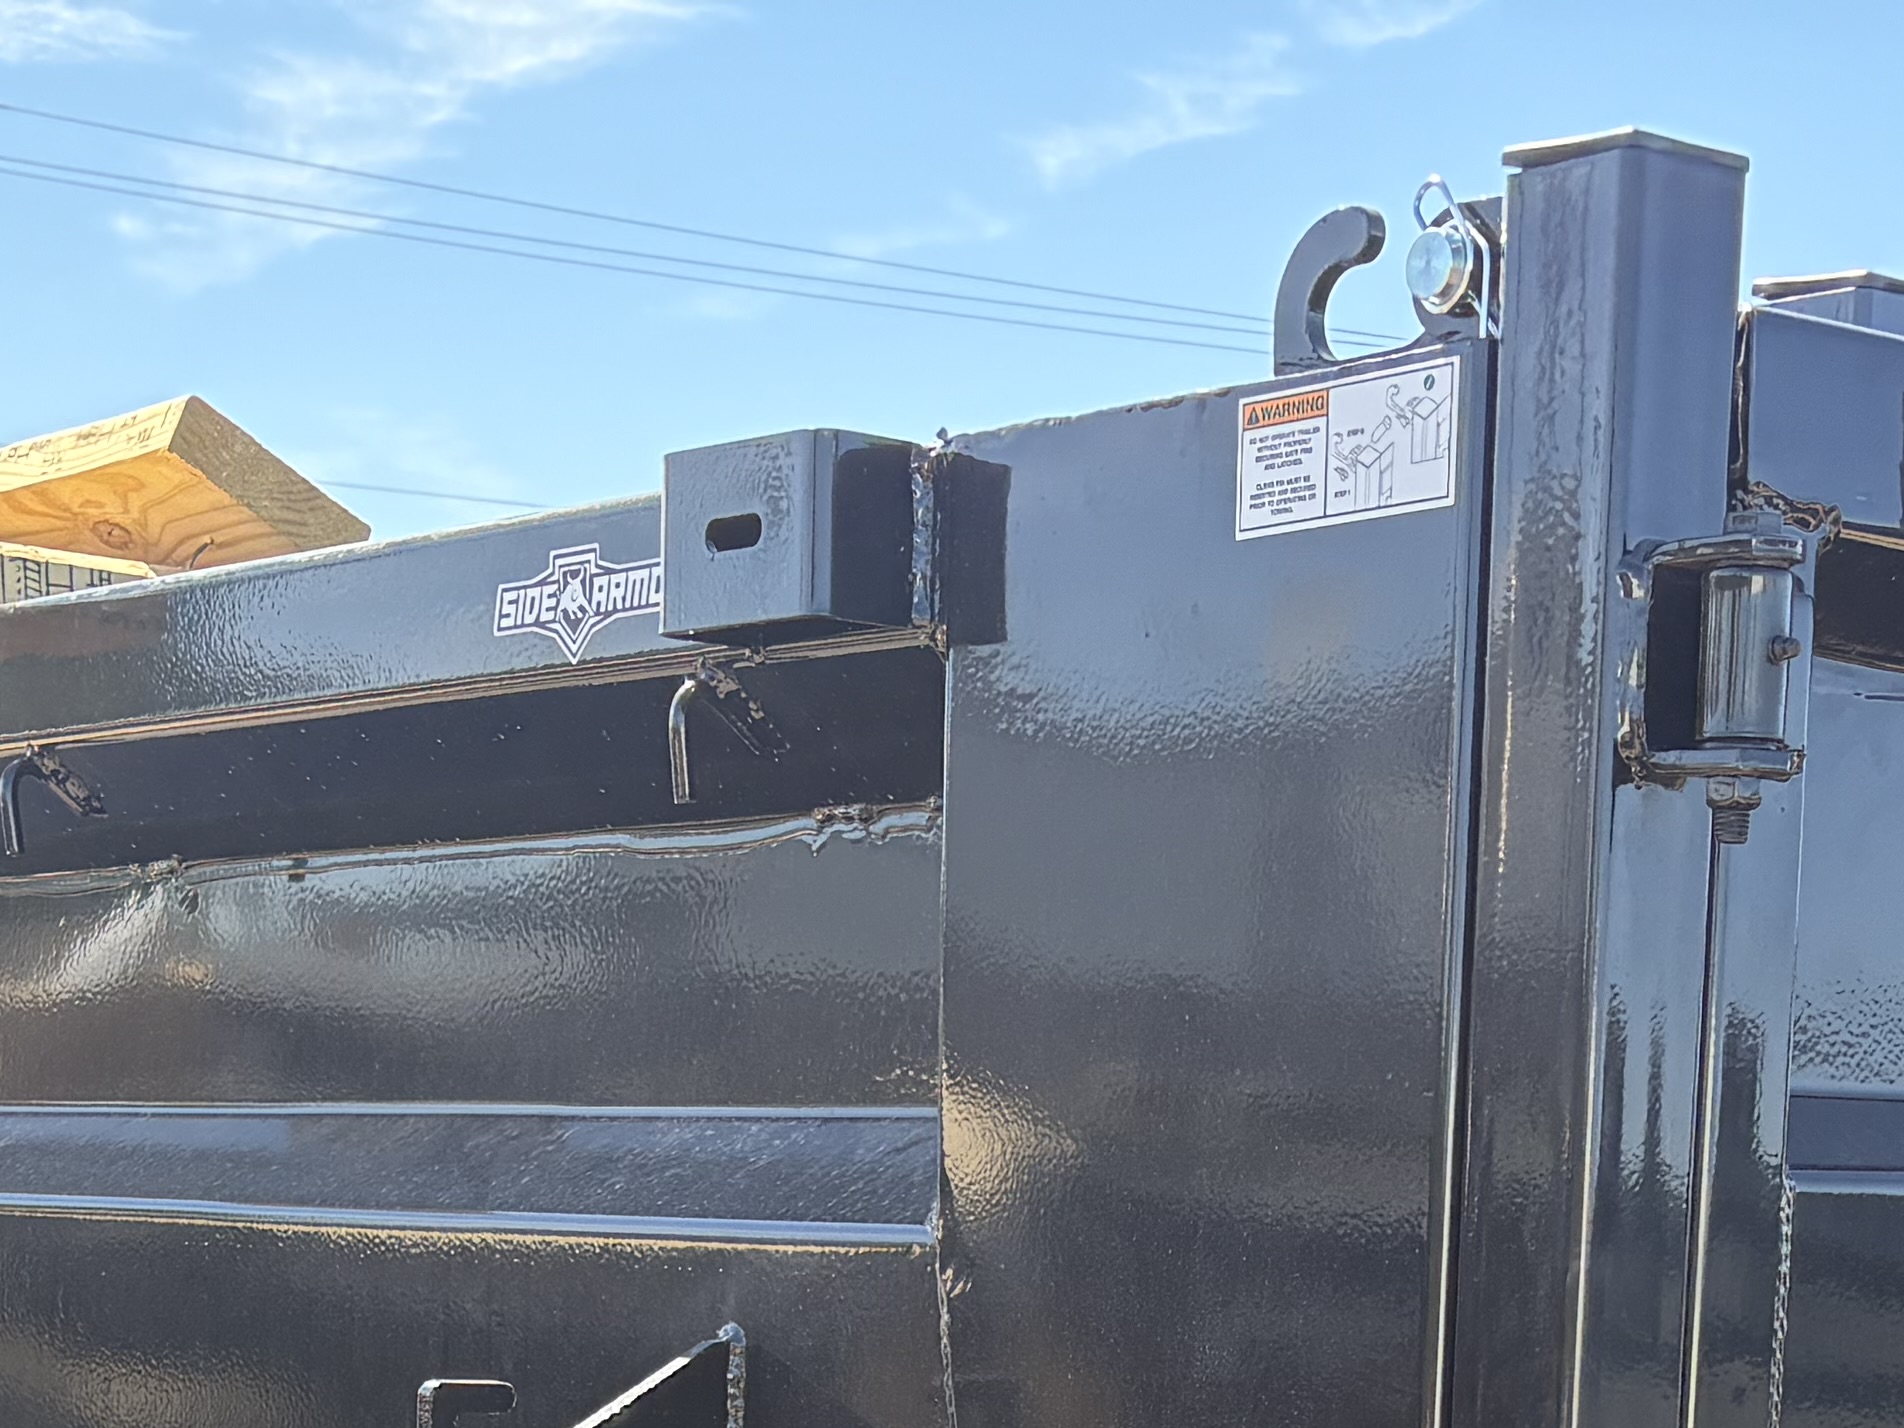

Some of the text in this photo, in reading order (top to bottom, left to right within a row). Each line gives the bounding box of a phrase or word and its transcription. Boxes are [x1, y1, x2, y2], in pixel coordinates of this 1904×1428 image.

[1261, 395, 1325, 421] WARNING
[499, 566, 662, 628] SIDE ARMO
